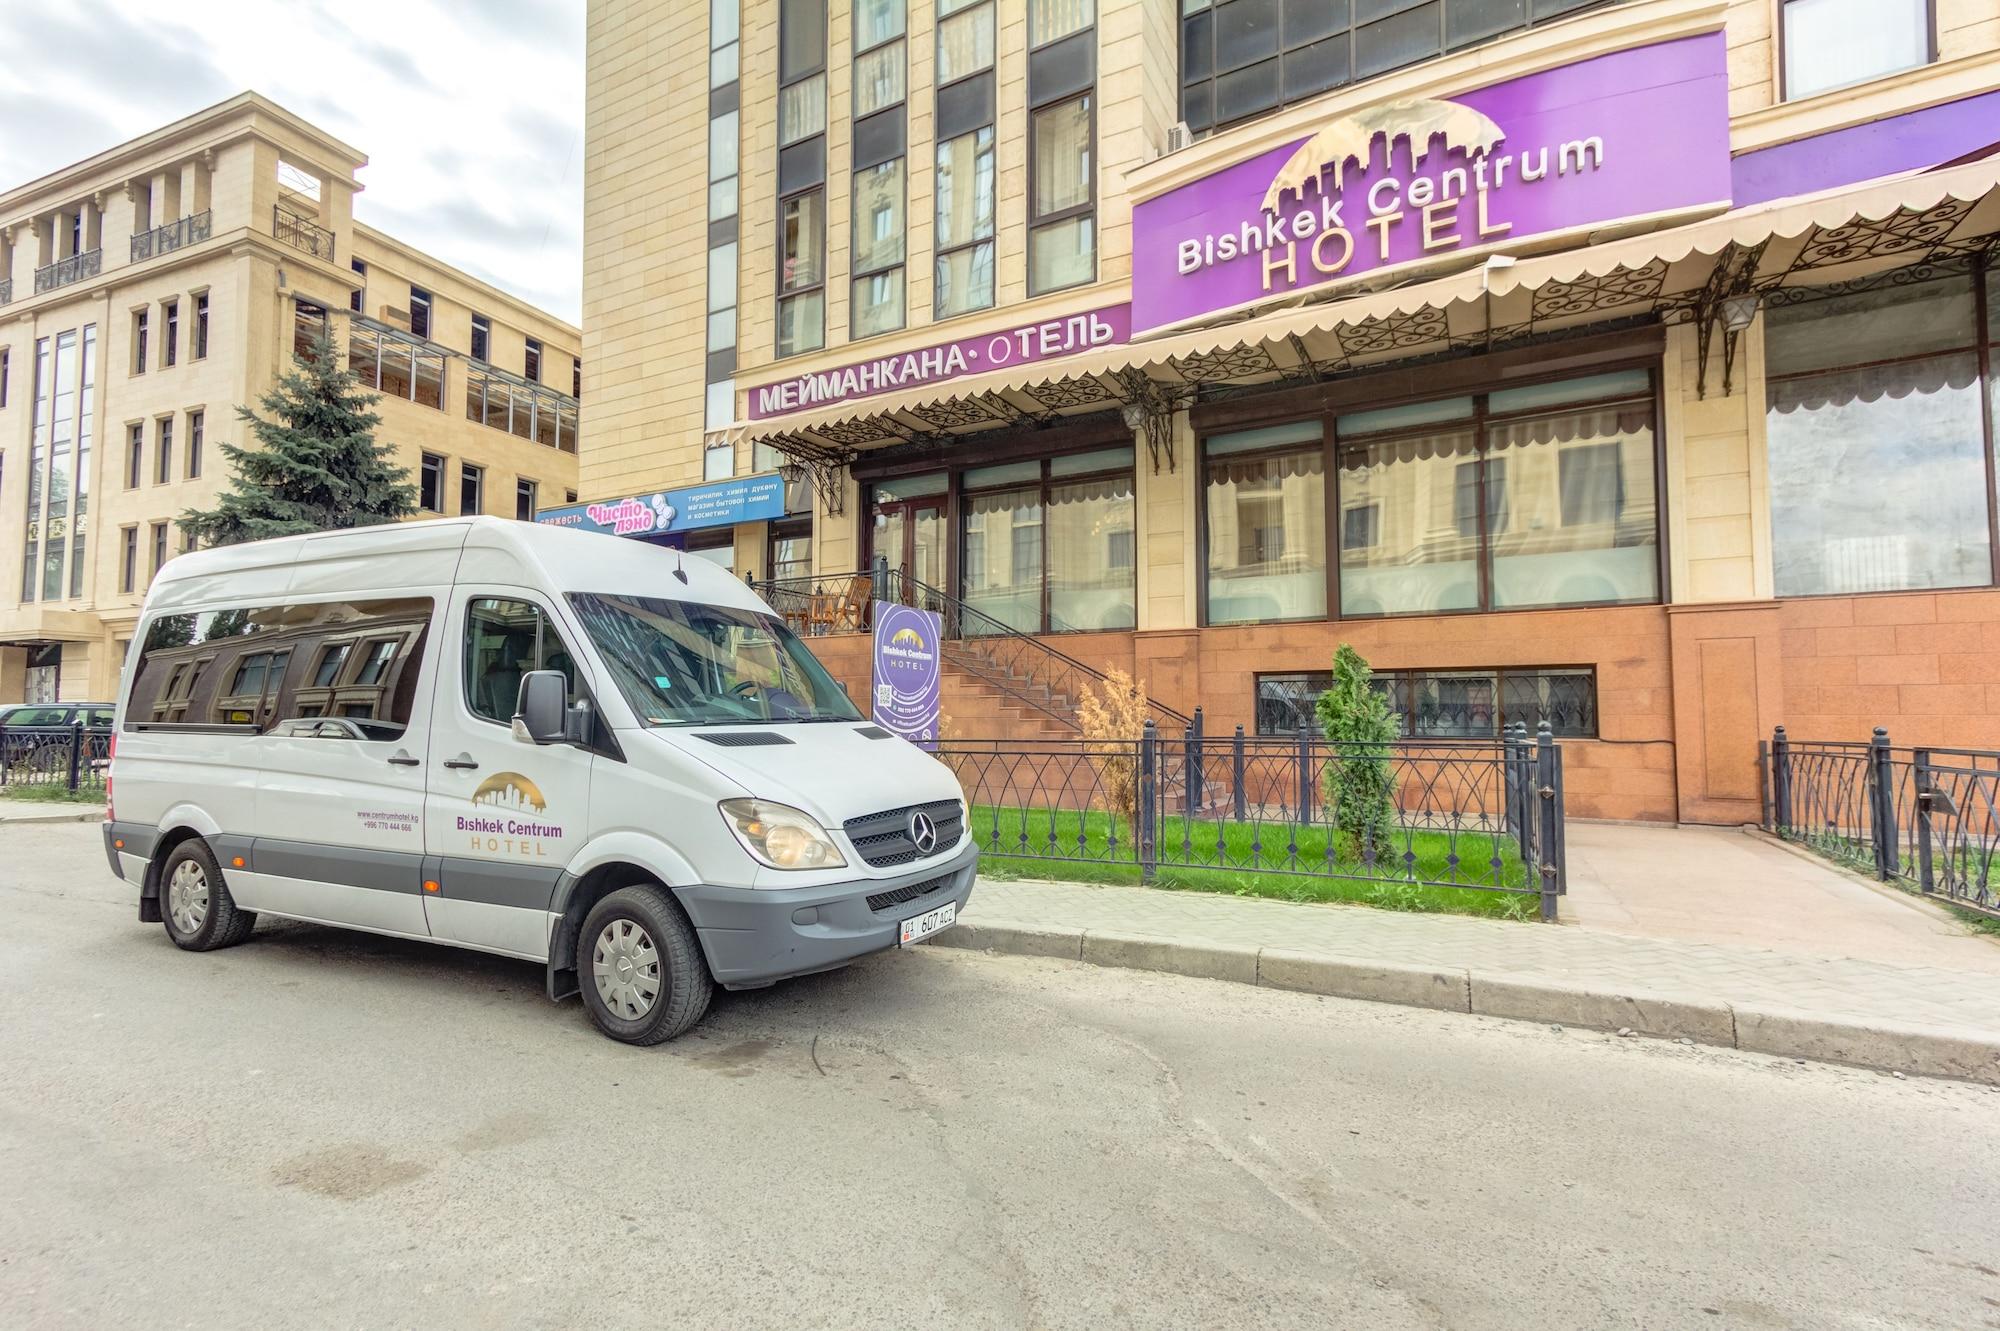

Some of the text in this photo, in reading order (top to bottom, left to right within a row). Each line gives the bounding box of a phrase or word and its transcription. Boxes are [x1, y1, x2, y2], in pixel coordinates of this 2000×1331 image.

[1177, 135, 1604, 276] Bishkek Centrum
[1260, 188, 1513, 291] HOTEL
[759, 312, 1114, 415] МЕЙМАНКАНА ОТЕЛЬ
[587, 500, 643, 524] Чисто
[687, 502, 715, 512] магазин
[891, 660, 925, 671] HOTEL
[357, 811, 419, 823] www.centrumhotel.kg
[378, 821, 389, 830] 770
[389, 822, 400, 831] 444
[507, 820, 563, 838] Centrum
[471, 836, 548, 856] HOTEL
[921, 912, 939, 933] 607
